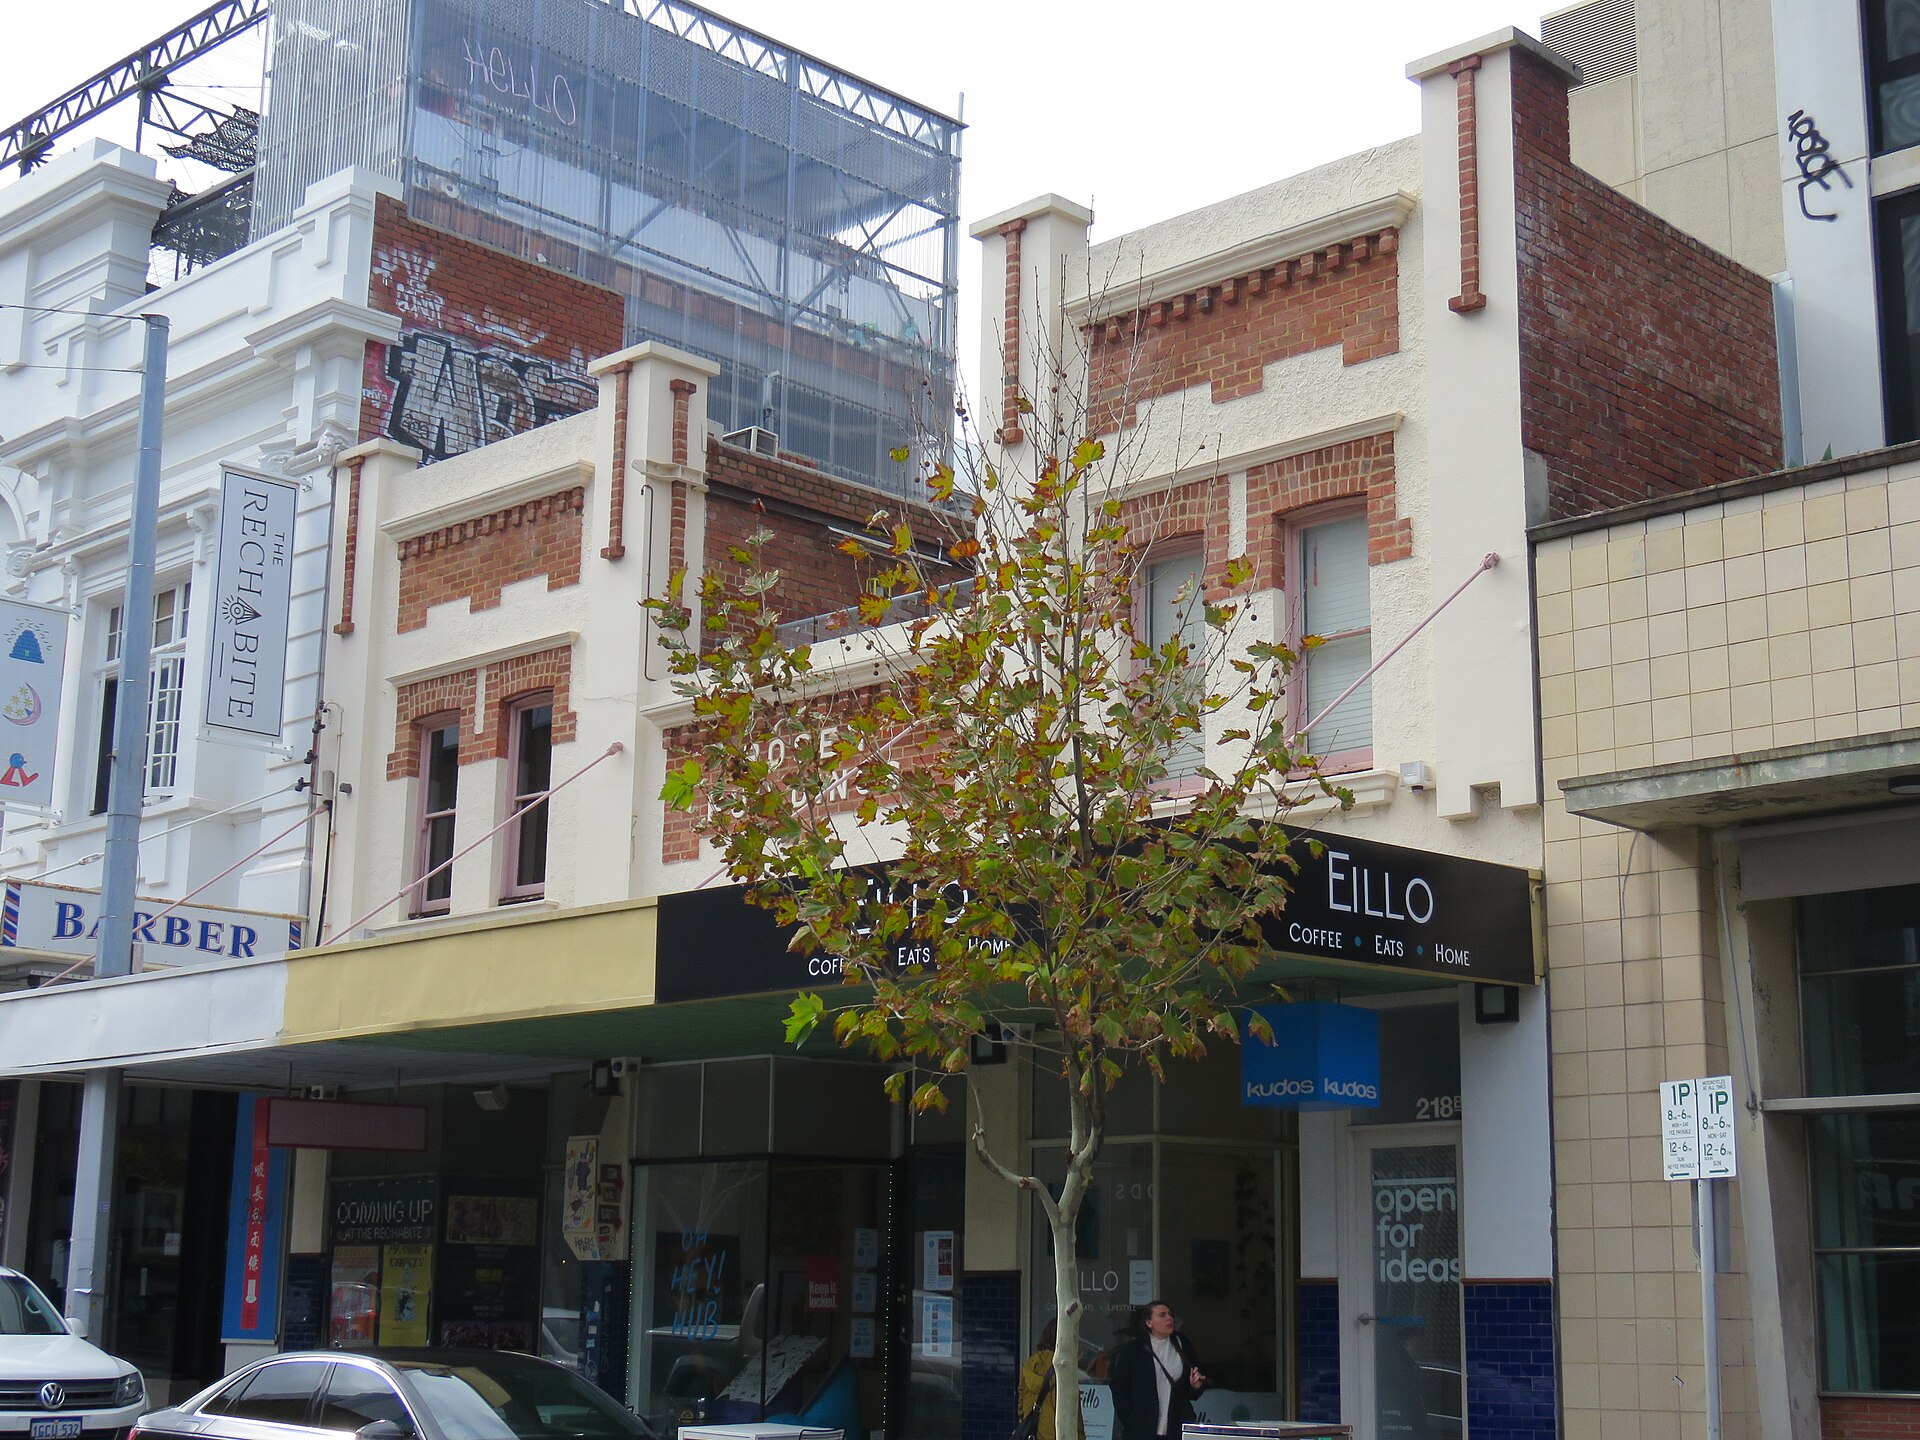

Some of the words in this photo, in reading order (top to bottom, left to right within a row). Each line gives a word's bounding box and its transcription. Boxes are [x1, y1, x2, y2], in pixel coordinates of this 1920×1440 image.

[273, 532, 286, 567] THE
[898, 947, 931, 967] EATS
[1375, 934, 1404, 957] EATS
[1435, 943, 1471, 967] HOME
[808, 956, 845, 977] COFF
[1247, 1079, 1315, 1098] kudos
[1324, 1078, 1377, 1099] kudos
[1671, 1083, 1691, 1106] 1P
[1708, 1090, 1729, 1115] 1P
[337, 1201, 405, 1224] COMING
[409, 1199, 433, 1223] UP
[1375, 1186, 1457, 1222] open
[344, 1228, 356, 1241] AT
[356, 1227, 373, 1240] THE
[374, 1226, 423, 1240] RECHABITE
[1377, 1215, 1424, 1248] for
[1379, 1250, 1460, 1283] ideas
[809, 1281, 829, 1296] Keep
[1081, 1271, 1119, 1291] LLO
[671, 1301, 718, 1342] HUB
